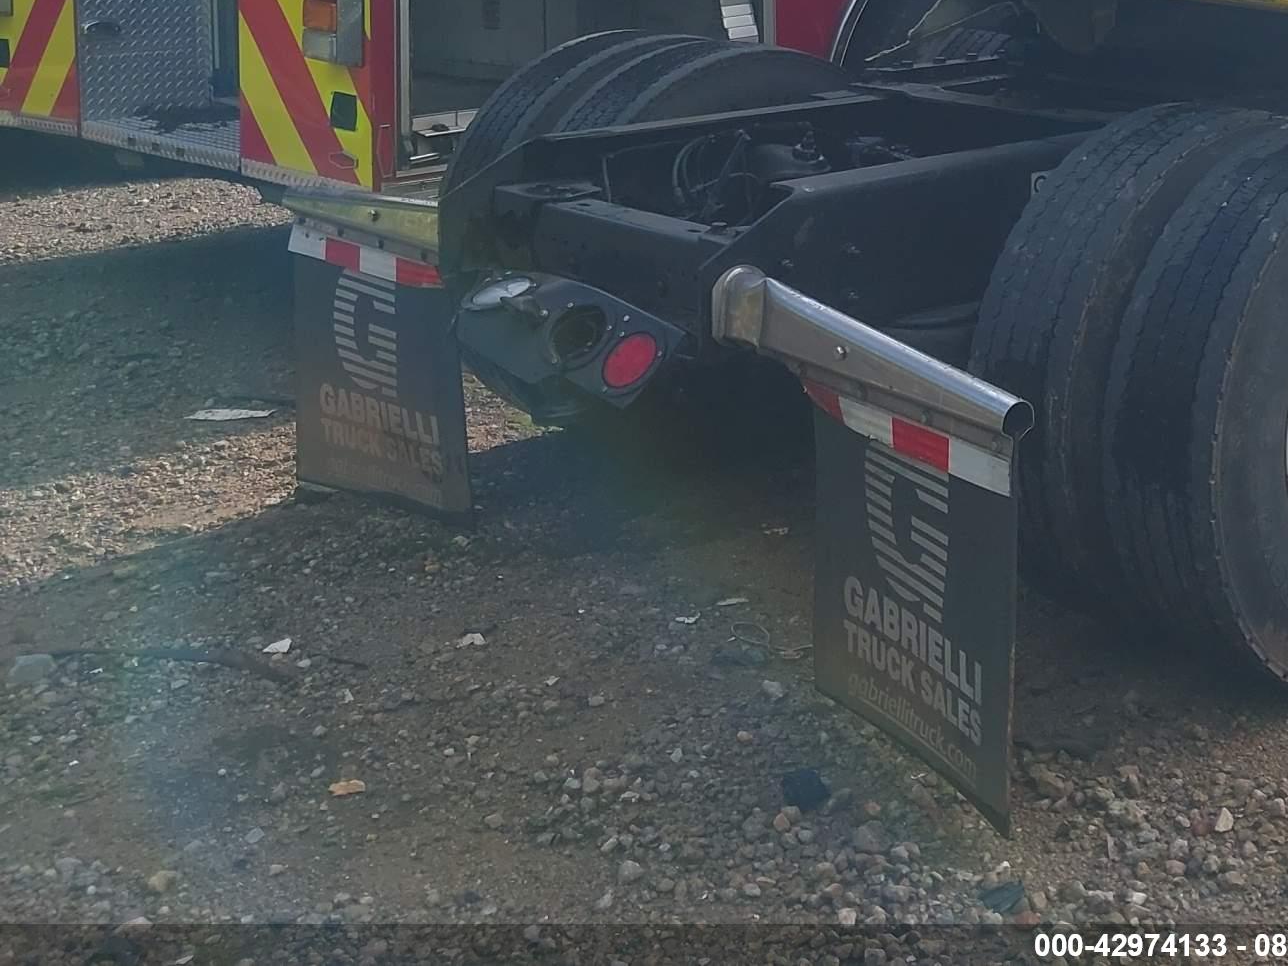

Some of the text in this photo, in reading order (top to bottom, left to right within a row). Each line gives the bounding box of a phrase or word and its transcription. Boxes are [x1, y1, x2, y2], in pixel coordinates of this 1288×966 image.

[320, 383, 440, 447] GABRIELLI
[320, 417, 442, 476] TRUCK SALES
[843, 618, 983, 747] TRUCK SALES
[844, 575, 983, 707] GABRIELLI
[849, 672, 978, 779] gabriellitruck.com
